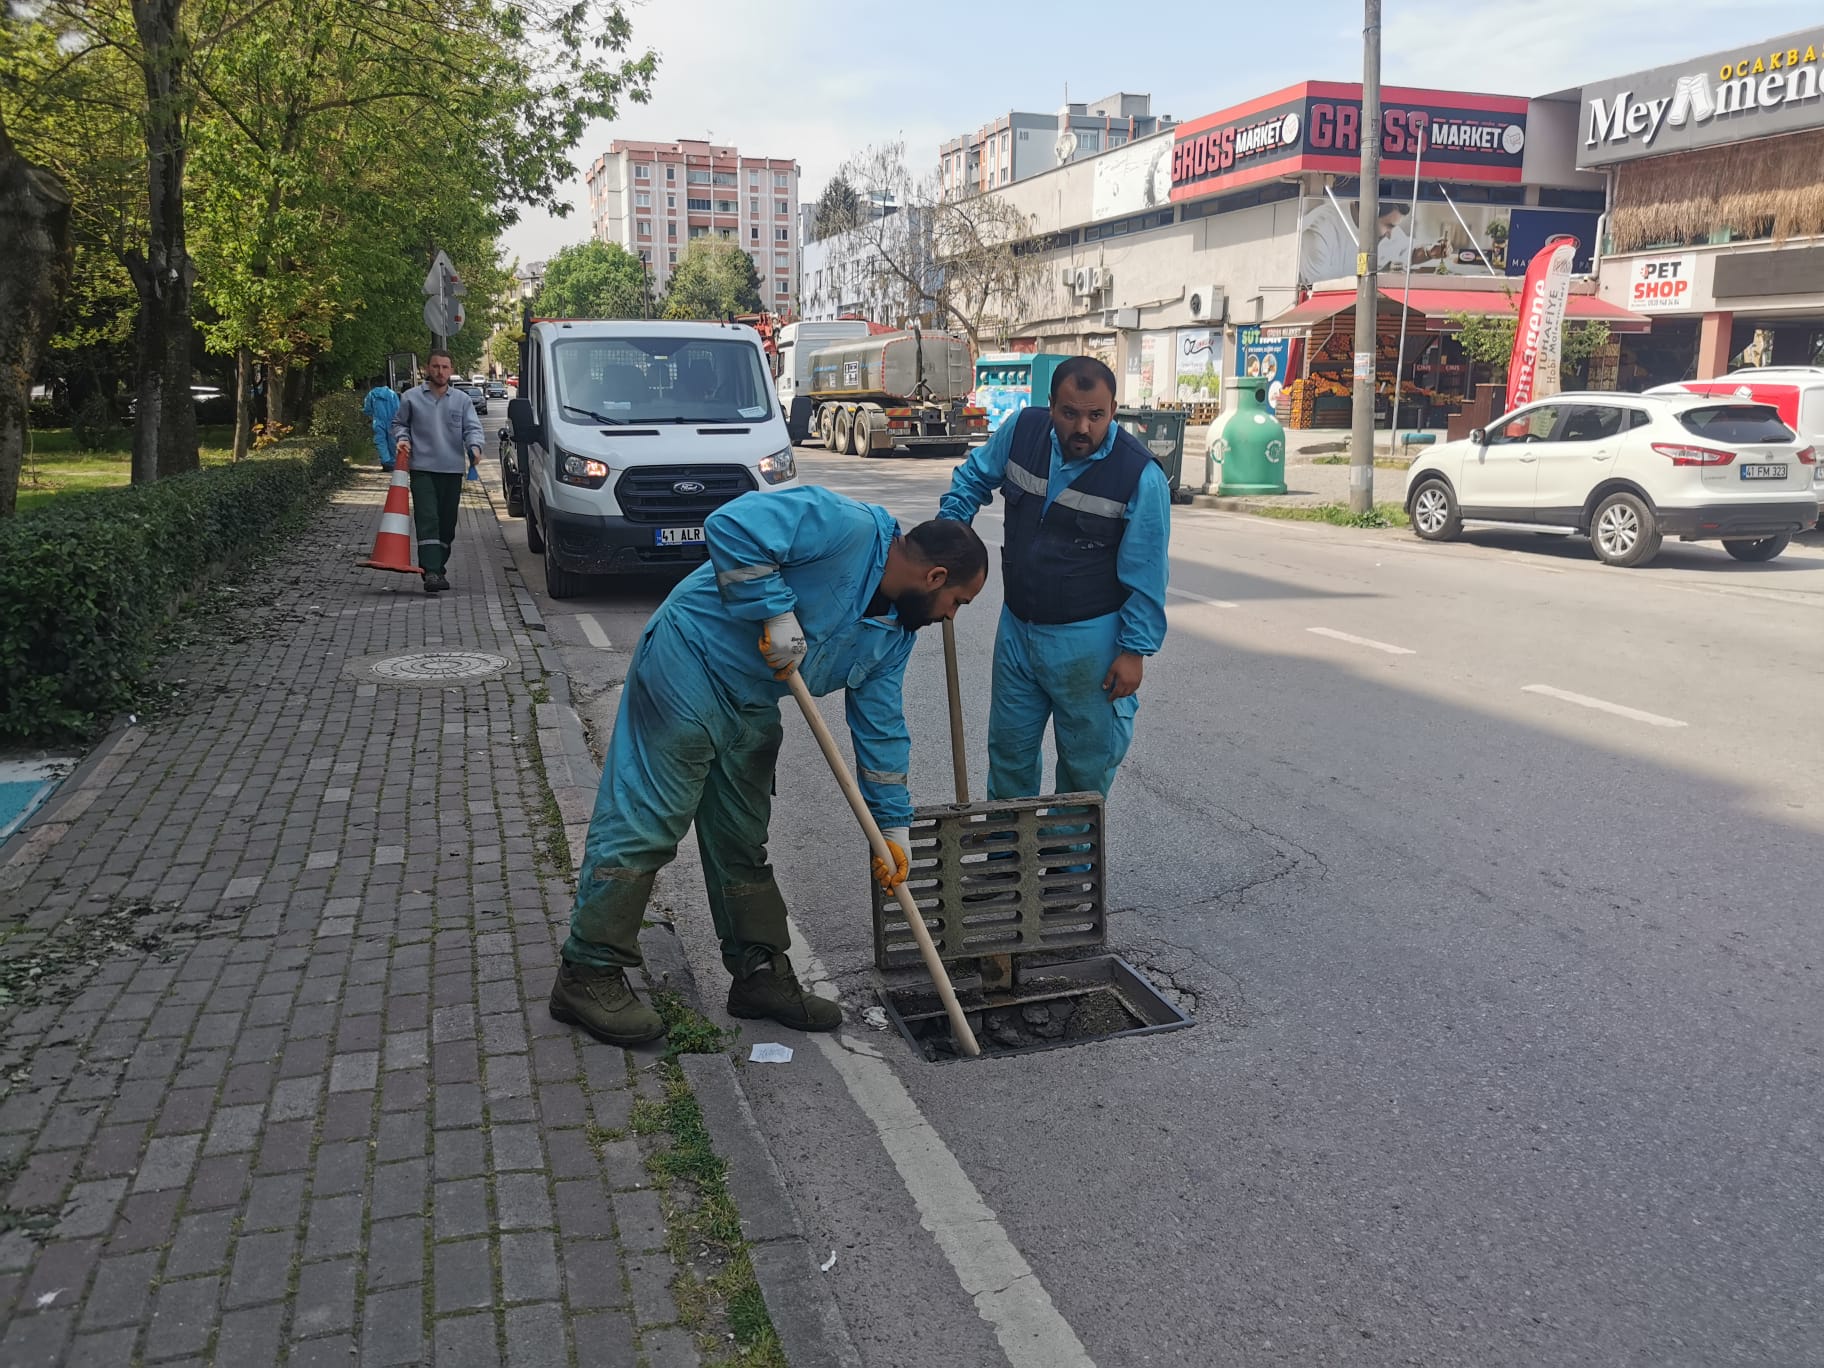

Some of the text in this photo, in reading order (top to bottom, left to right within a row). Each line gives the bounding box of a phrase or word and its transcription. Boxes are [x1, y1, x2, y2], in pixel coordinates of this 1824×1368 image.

[1720, 45, 1824, 81] OCAKBA
[1310, 103, 1502, 154] GRSS MARKET
[1171, 120, 1283, 183] GROSS MARKET
[1643, 260, 1682, 280] PET
[1633, 280, 1688, 299] SHOP
[1513, 279, 1546, 412] omagene
[1746, 466, 1786, 477] 41 FM 323
[662, 530, 675, 542] 41
[681, 529, 701, 541] ALR
